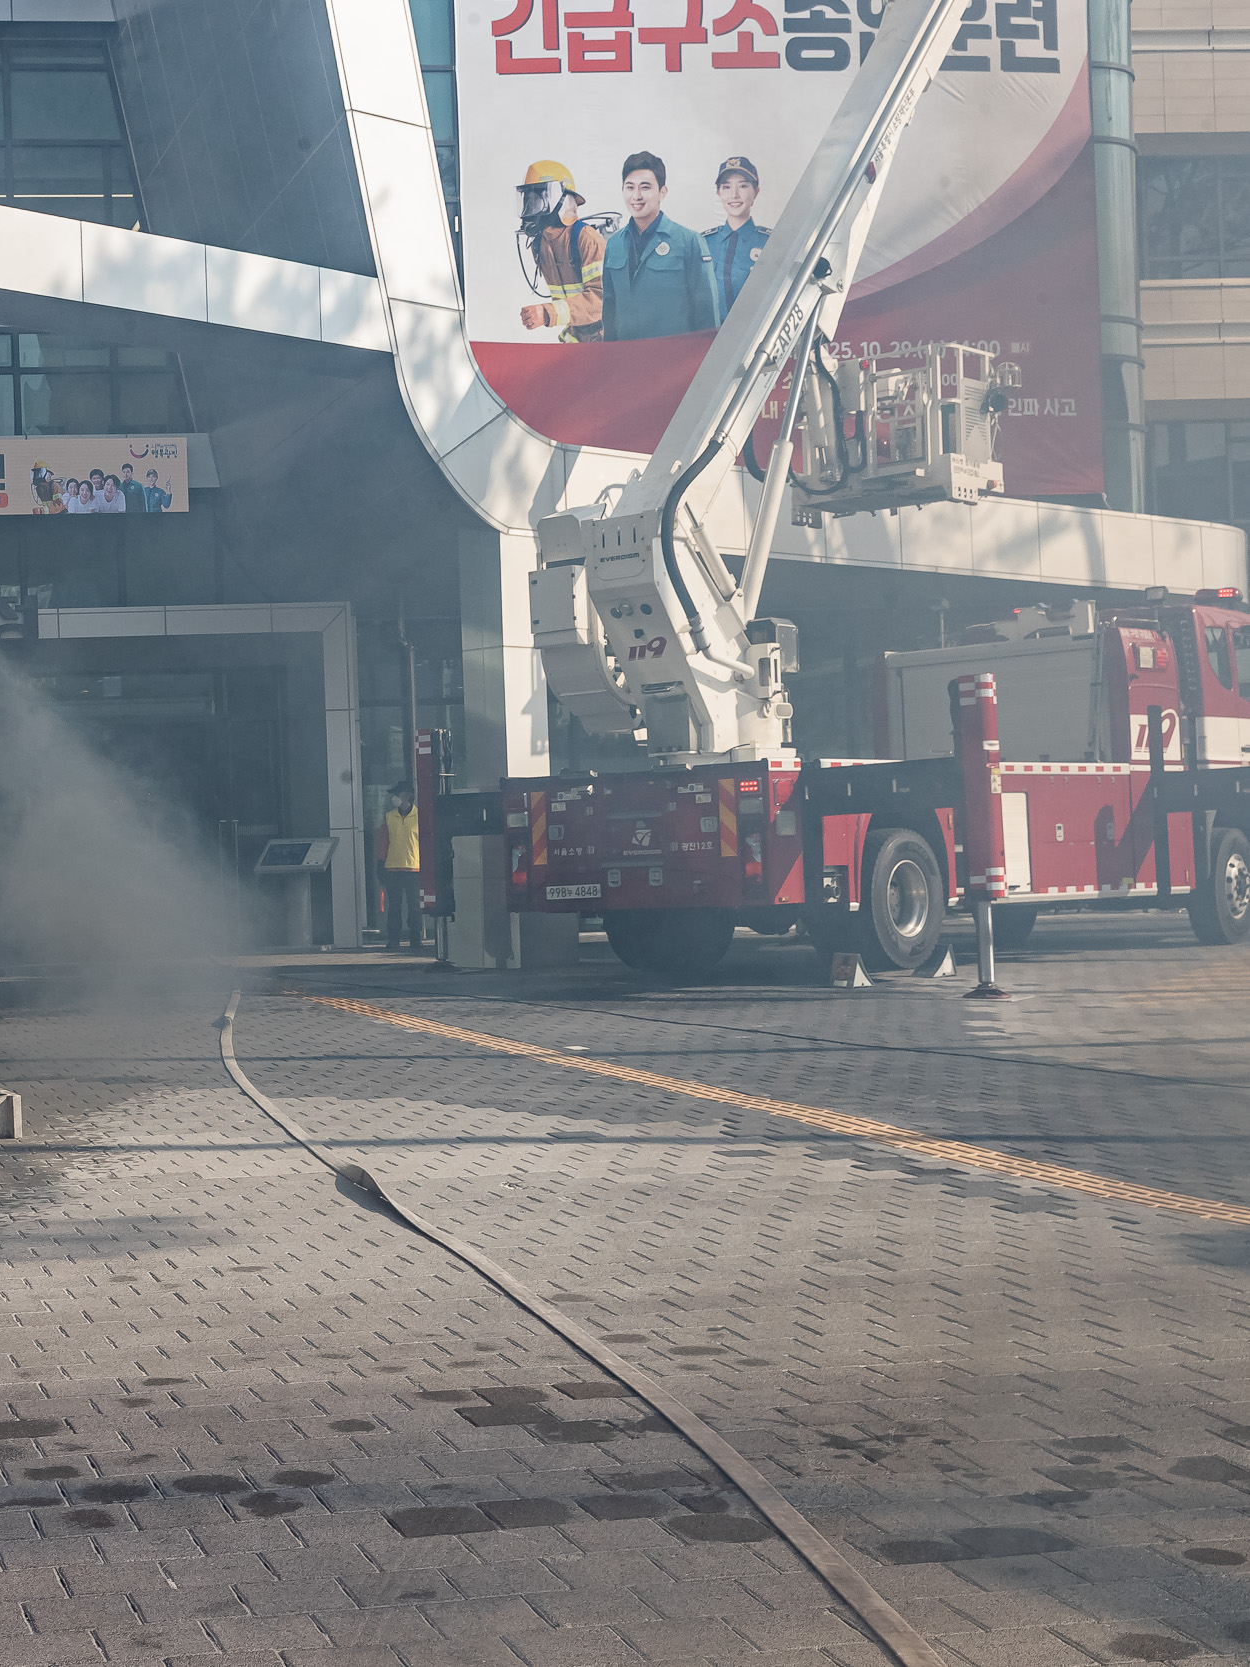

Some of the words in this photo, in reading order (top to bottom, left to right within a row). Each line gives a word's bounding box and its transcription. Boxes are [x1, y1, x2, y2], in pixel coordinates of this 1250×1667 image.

[1044, 398, 1077, 417] 사고
[600, 552, 639, 563] EVERDIGM
[628, 636, 667, 661] 119
[681, 842, 713, 851] 광진12호
